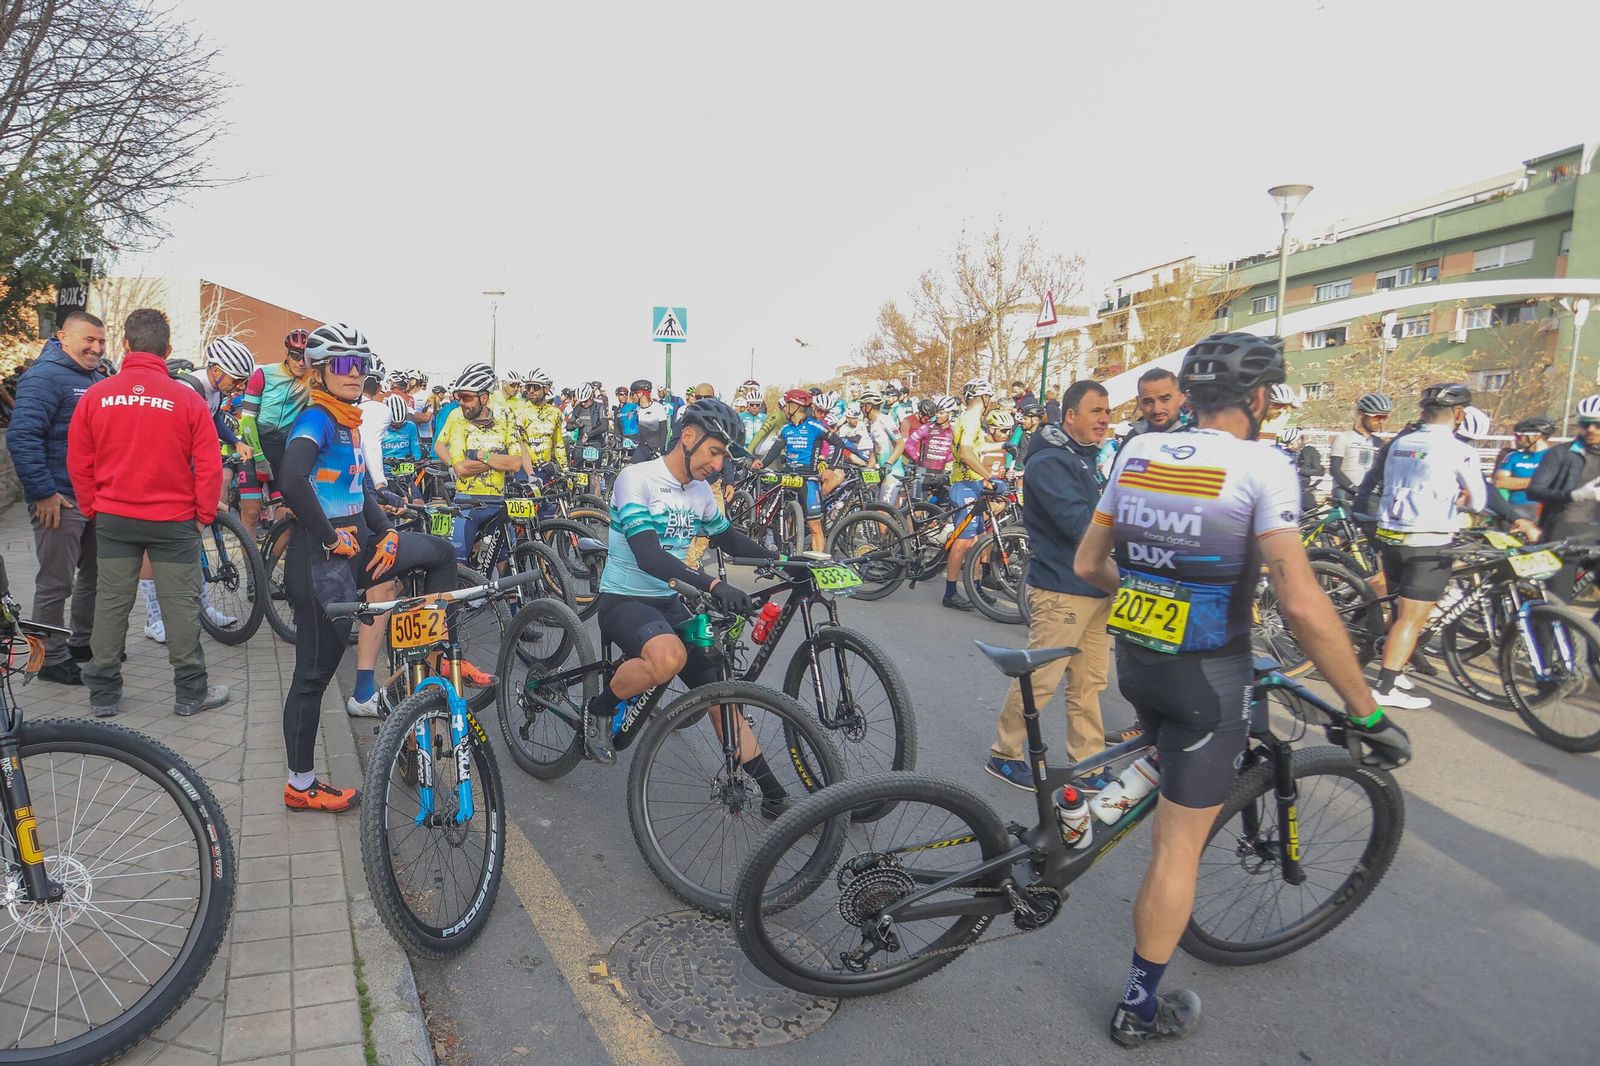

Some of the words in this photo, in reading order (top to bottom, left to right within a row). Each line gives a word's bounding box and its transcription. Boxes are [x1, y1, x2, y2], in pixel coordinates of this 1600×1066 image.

[101, 394, 175, 412] MAPFRE
[509, 502, 533, 514] 206-1
[668, 513, 695, 527] BIKE
[1117, 495, 1203, 537] fibwi
[664, 527, 695, 539] RACE
[1127, 542, 1176, 569] DUX
[1114, 591, 1179, 633] 207-2
[396, 612, 439, 642] 505-2
[466, 712, 487, 743] AXXIS
